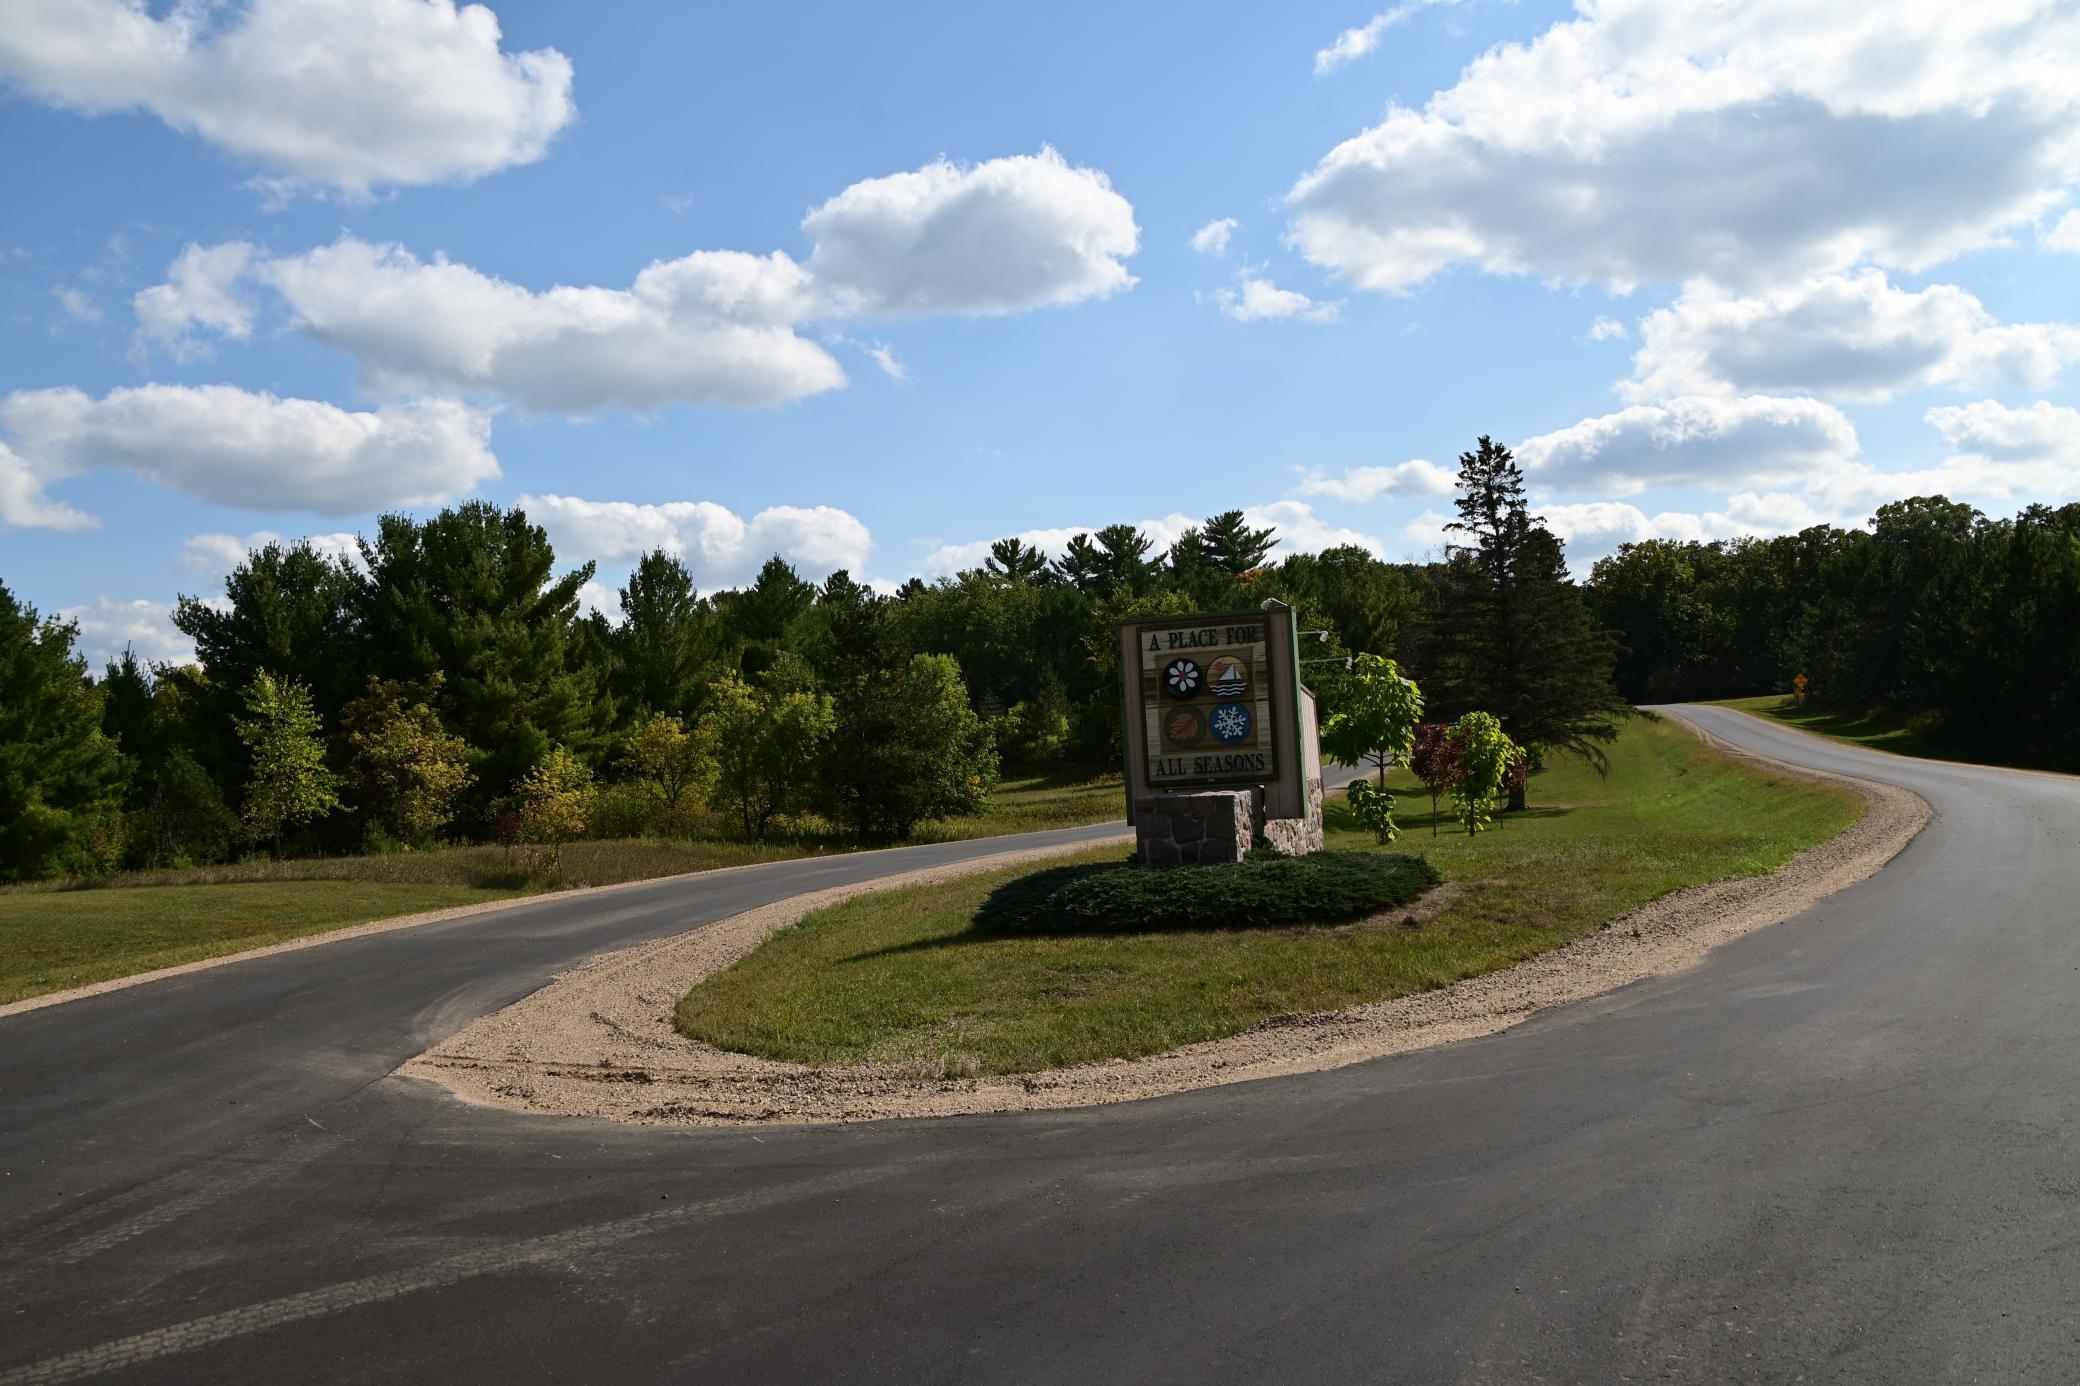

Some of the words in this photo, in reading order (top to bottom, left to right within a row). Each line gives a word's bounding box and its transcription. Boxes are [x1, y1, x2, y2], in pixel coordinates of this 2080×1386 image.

[1150, 633, 1161, 650] A
[1168, 629, 1218, 649] PLACE
[1226, 626, 1257, 645] FOR
[1156, 758, 1186, 776] ALL
[1194, 753, 1264, 774] SEASONS
